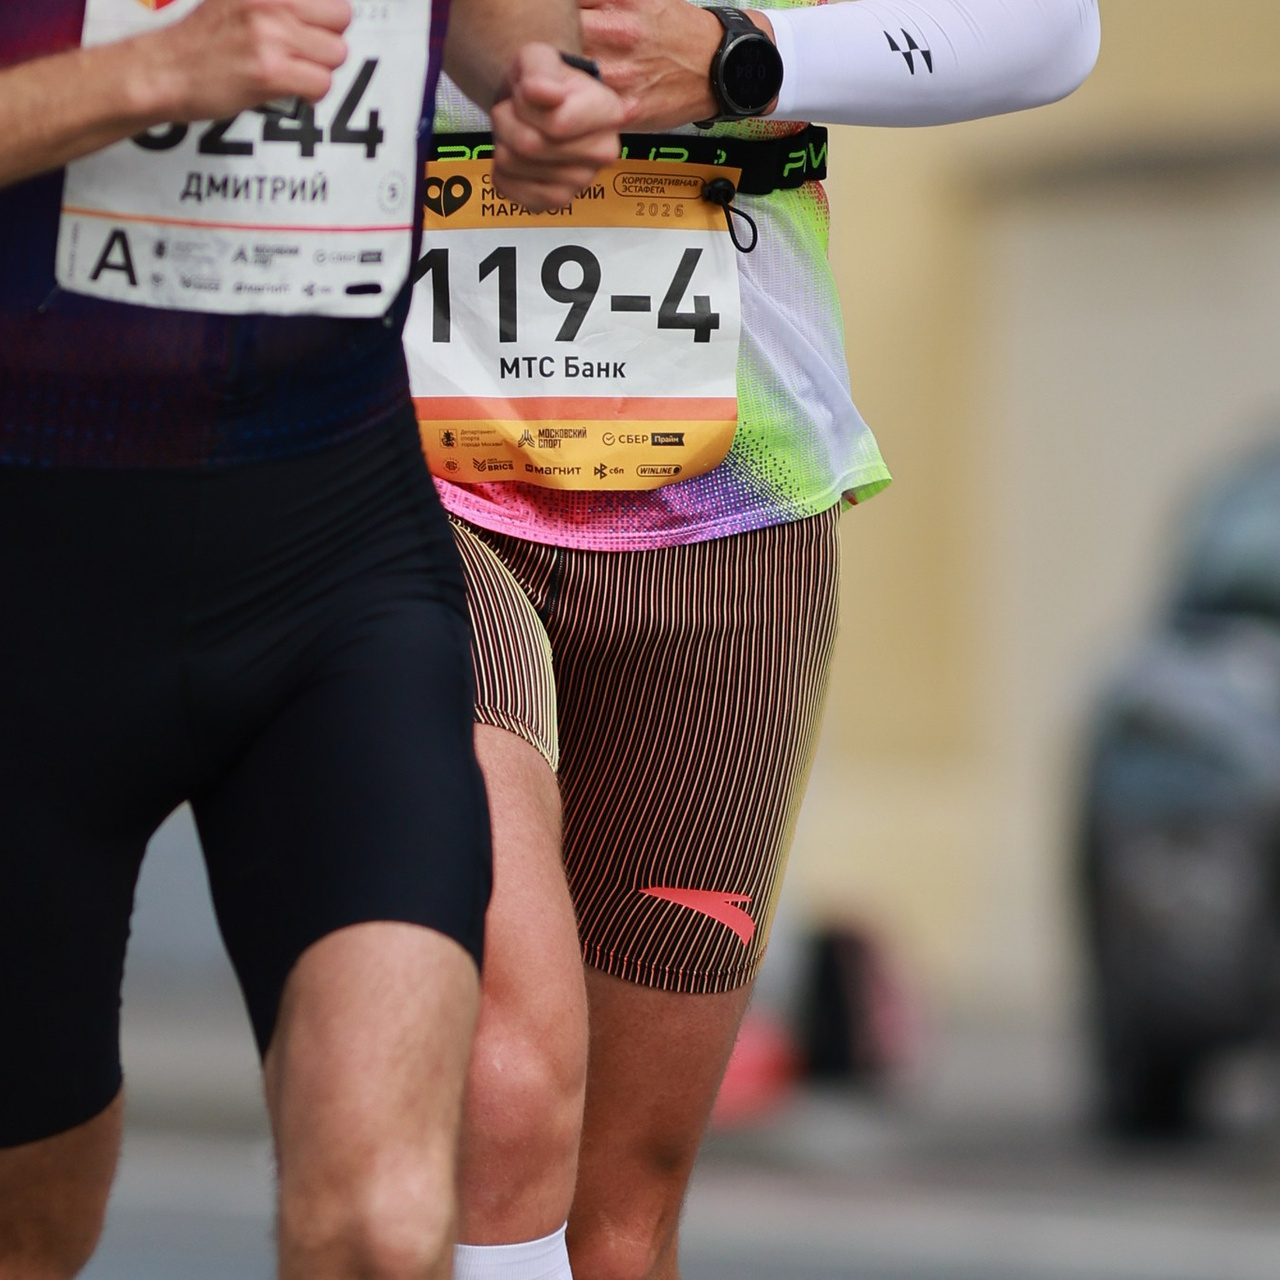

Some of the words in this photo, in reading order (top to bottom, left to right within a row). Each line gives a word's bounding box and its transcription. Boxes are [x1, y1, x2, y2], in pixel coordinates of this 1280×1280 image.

[622, 176, 699, 187] КОРПОРАТИВНАЯ
[180, 173, 328, 202] ДМИТРИЙ
[622, 185, 666, 194] ЭСТАФЕТА
[482, 201, 573, 216] МАРАОН
[636, 201, 684, 217] 2026
[413, 244, 720, 344] 119-4
[500, 356, 555, 379] МТС
[564, 356, 627, 378] Банк
[538, 426, 588, 438] МОСКОВСКИЙ
[538, 438, 562, 449] СПОРТ
[618, 434, 649, 444] СБЕР
[487, 463, 514, 472] BRICS
[609, 467, 625, 475] сбп
[639, 467, 673, 475] WINLINE
